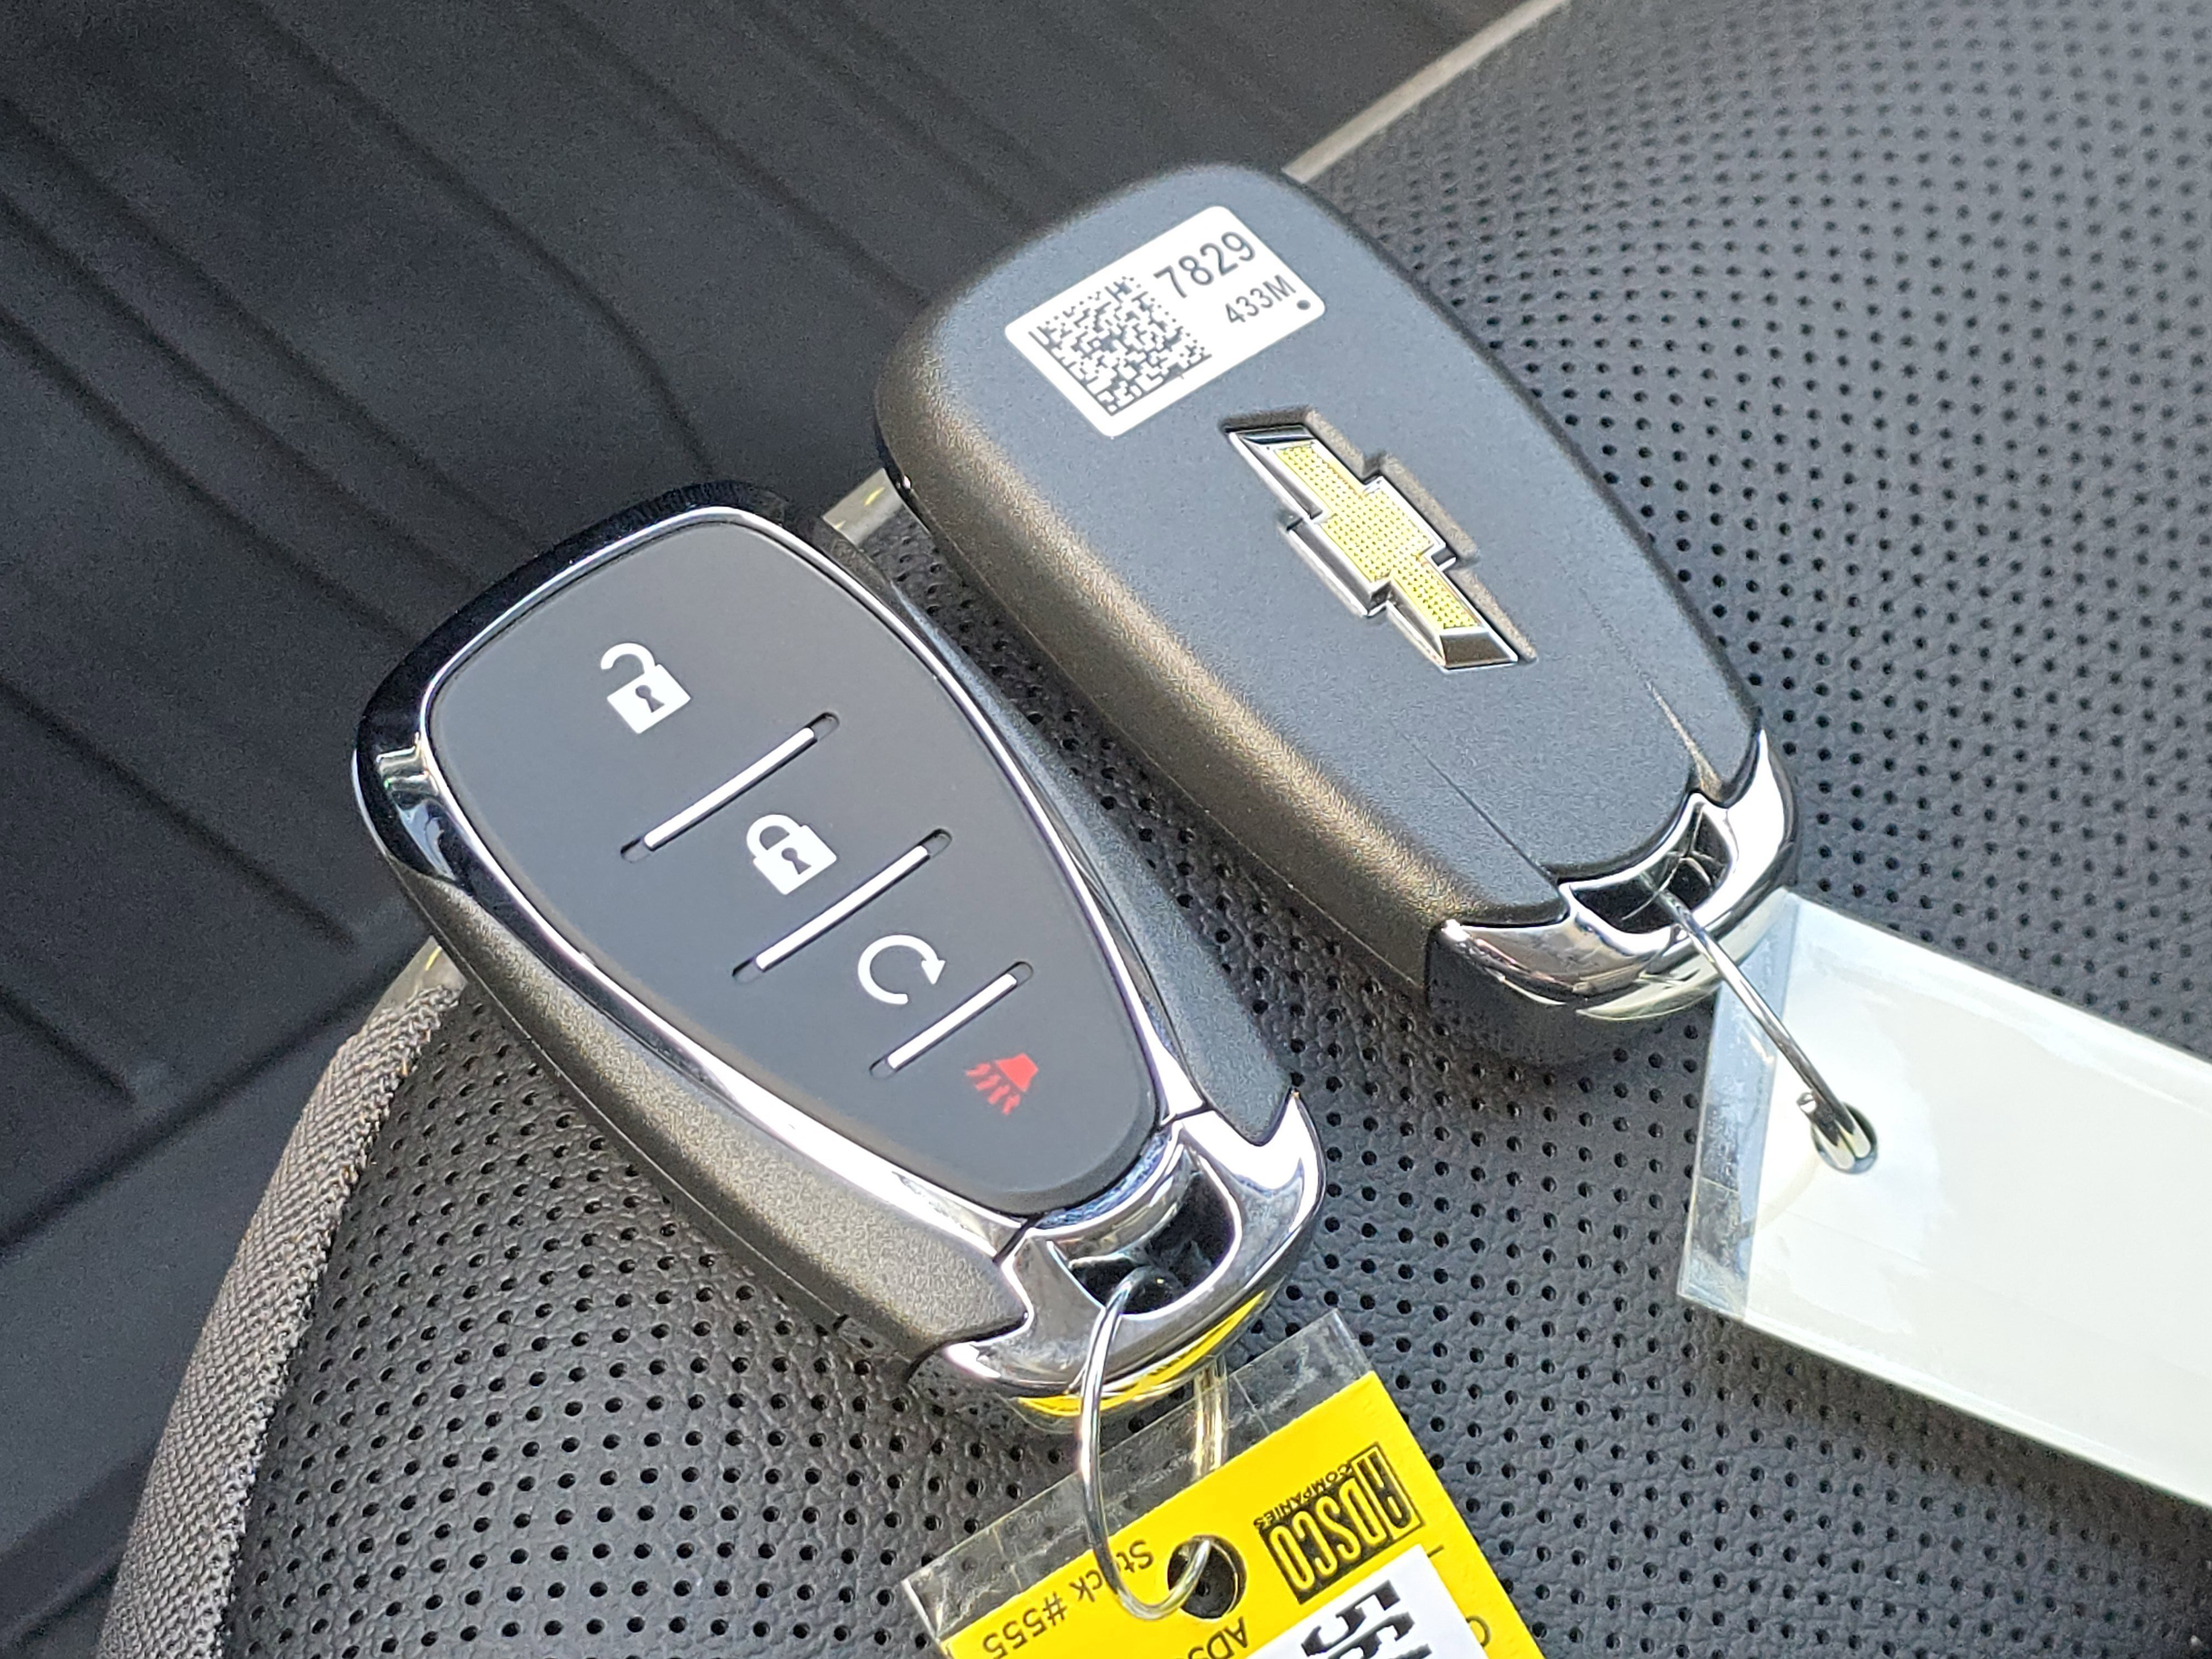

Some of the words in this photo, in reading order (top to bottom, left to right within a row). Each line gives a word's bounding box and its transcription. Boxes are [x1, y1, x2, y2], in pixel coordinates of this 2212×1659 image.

[1153, 231, 1256, 298] 7829
[1224, 274, 1296, 324] 433M
[1253, 1463, 1353, 1530] COMPANIES
[1266, 1448, 1419, 1594] ADSCO
[1068, 1539, 1154, 1603] Stck
[982, 1590, 1067, 1659] #555
[1301, 1579, 1433, 1659] 56
